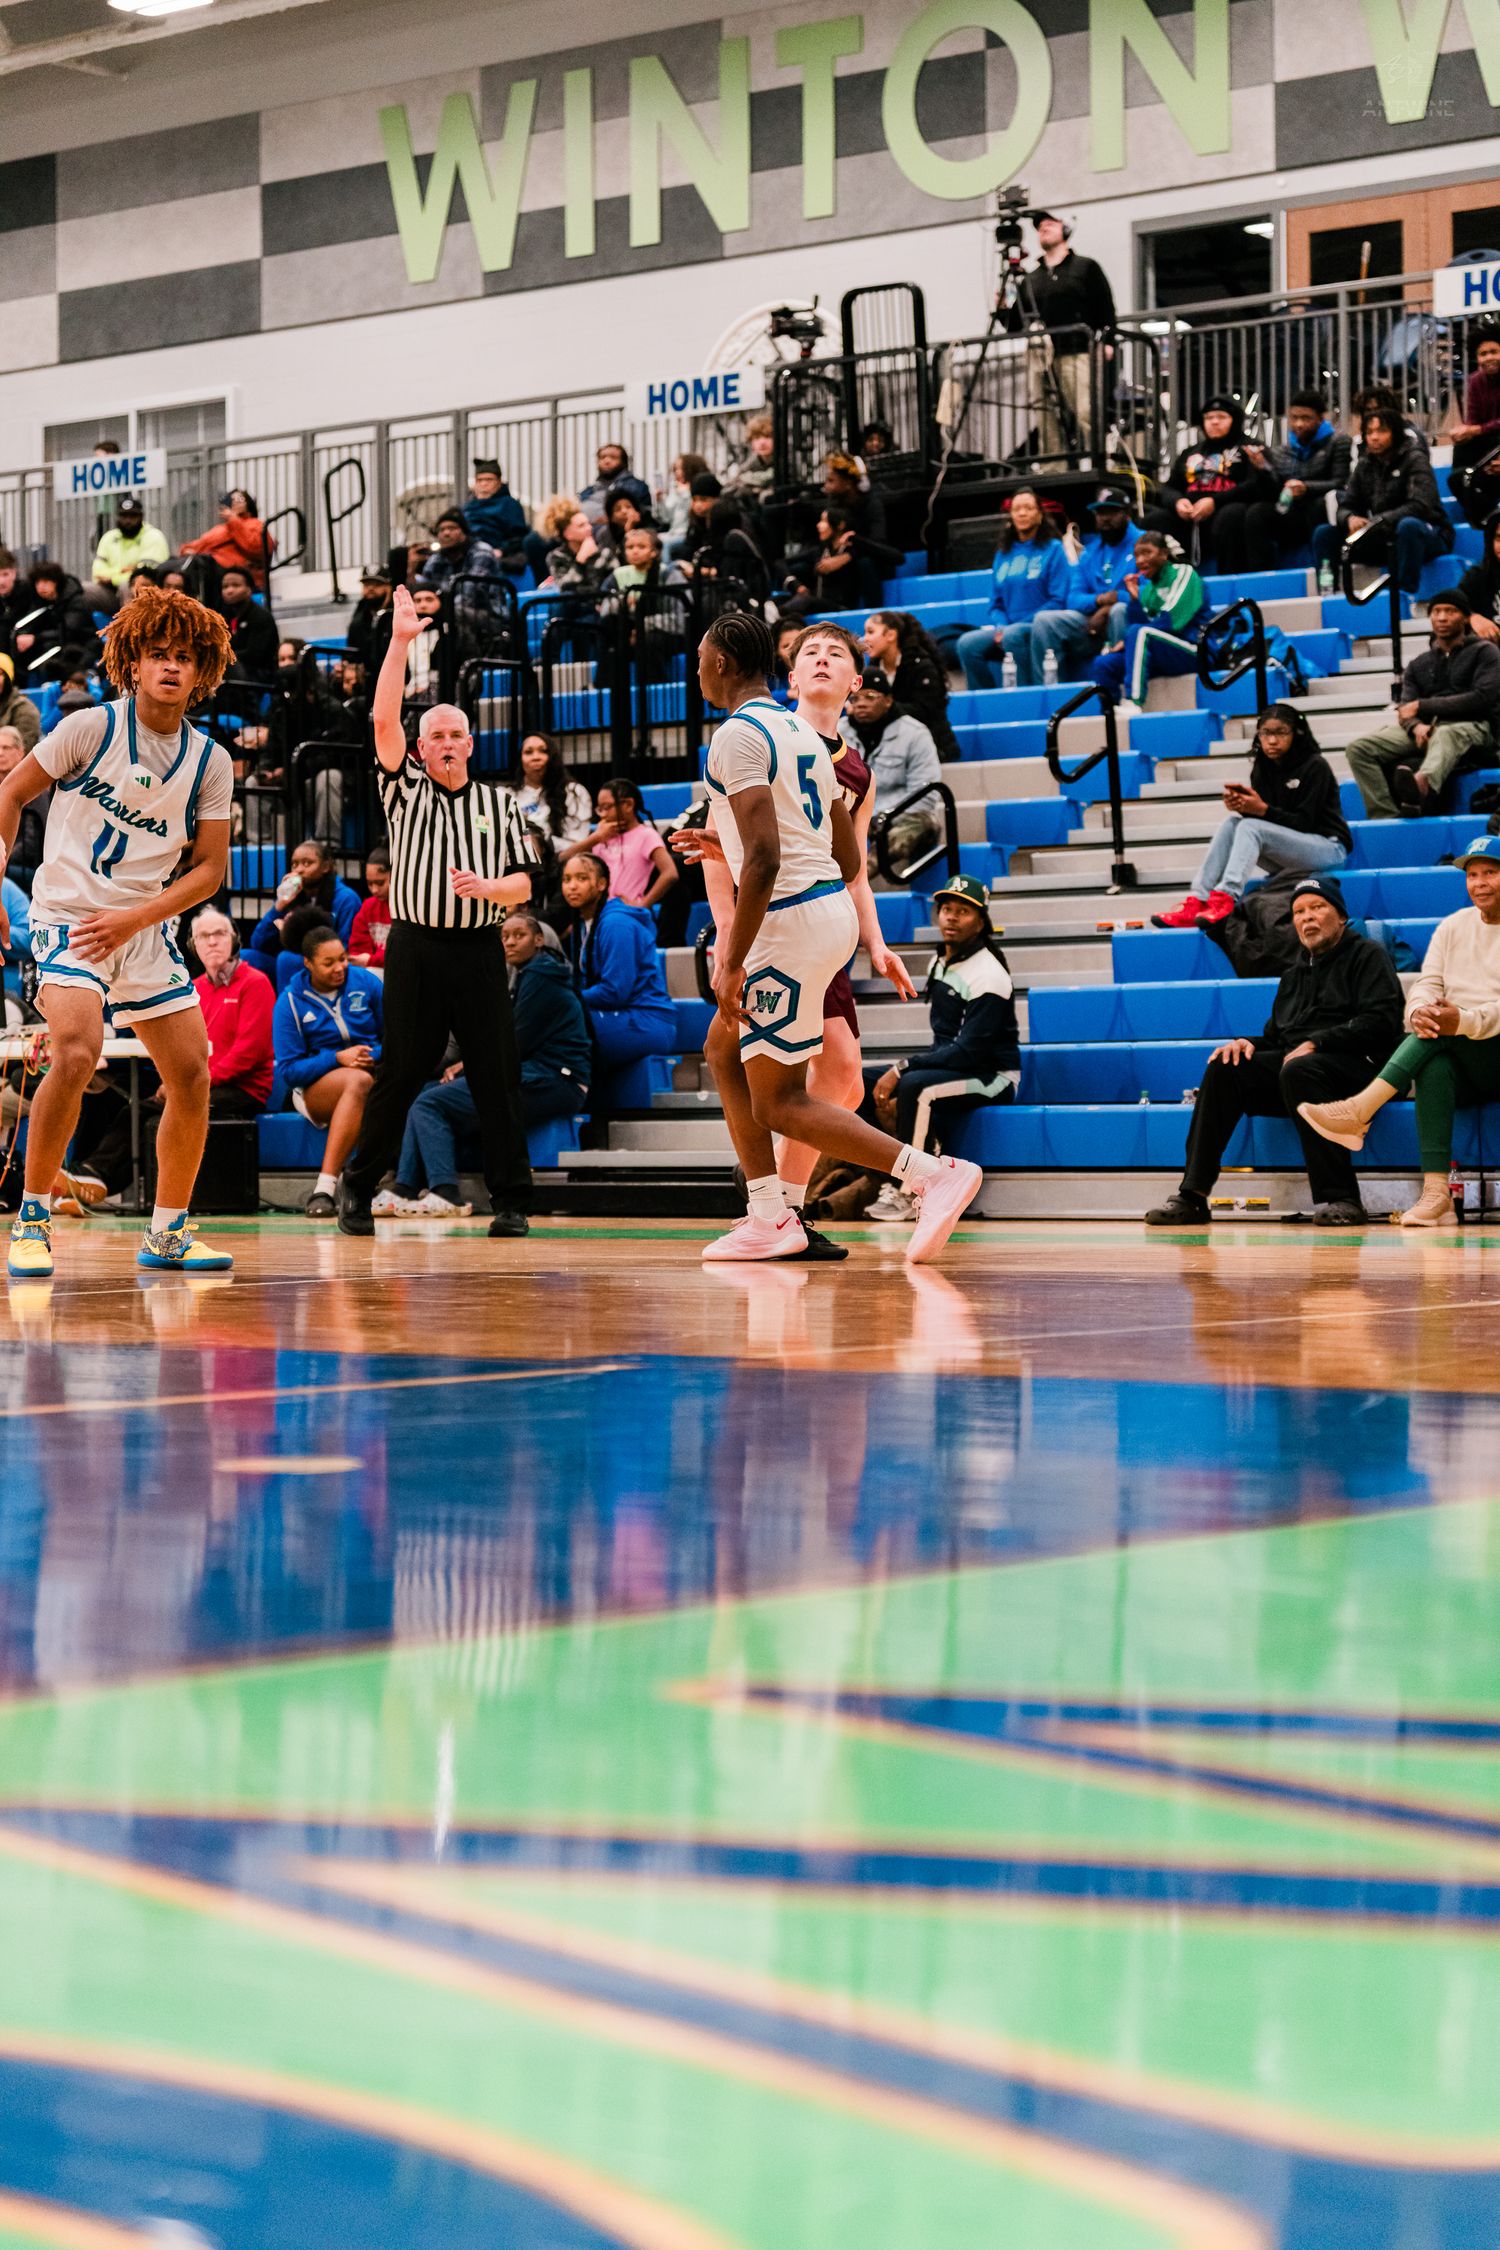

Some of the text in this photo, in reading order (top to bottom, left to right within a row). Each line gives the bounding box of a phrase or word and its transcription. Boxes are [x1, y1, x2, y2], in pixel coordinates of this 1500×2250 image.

[378, 0, 1231, 283] WINTON
[648, 373, 741, 415] HOME
[73, 456, 147, 493] HOME
[79, 776, 168, 838] Warriors
[797, 754, 824, 831] 5
[90, 818, 129, 879] 11
